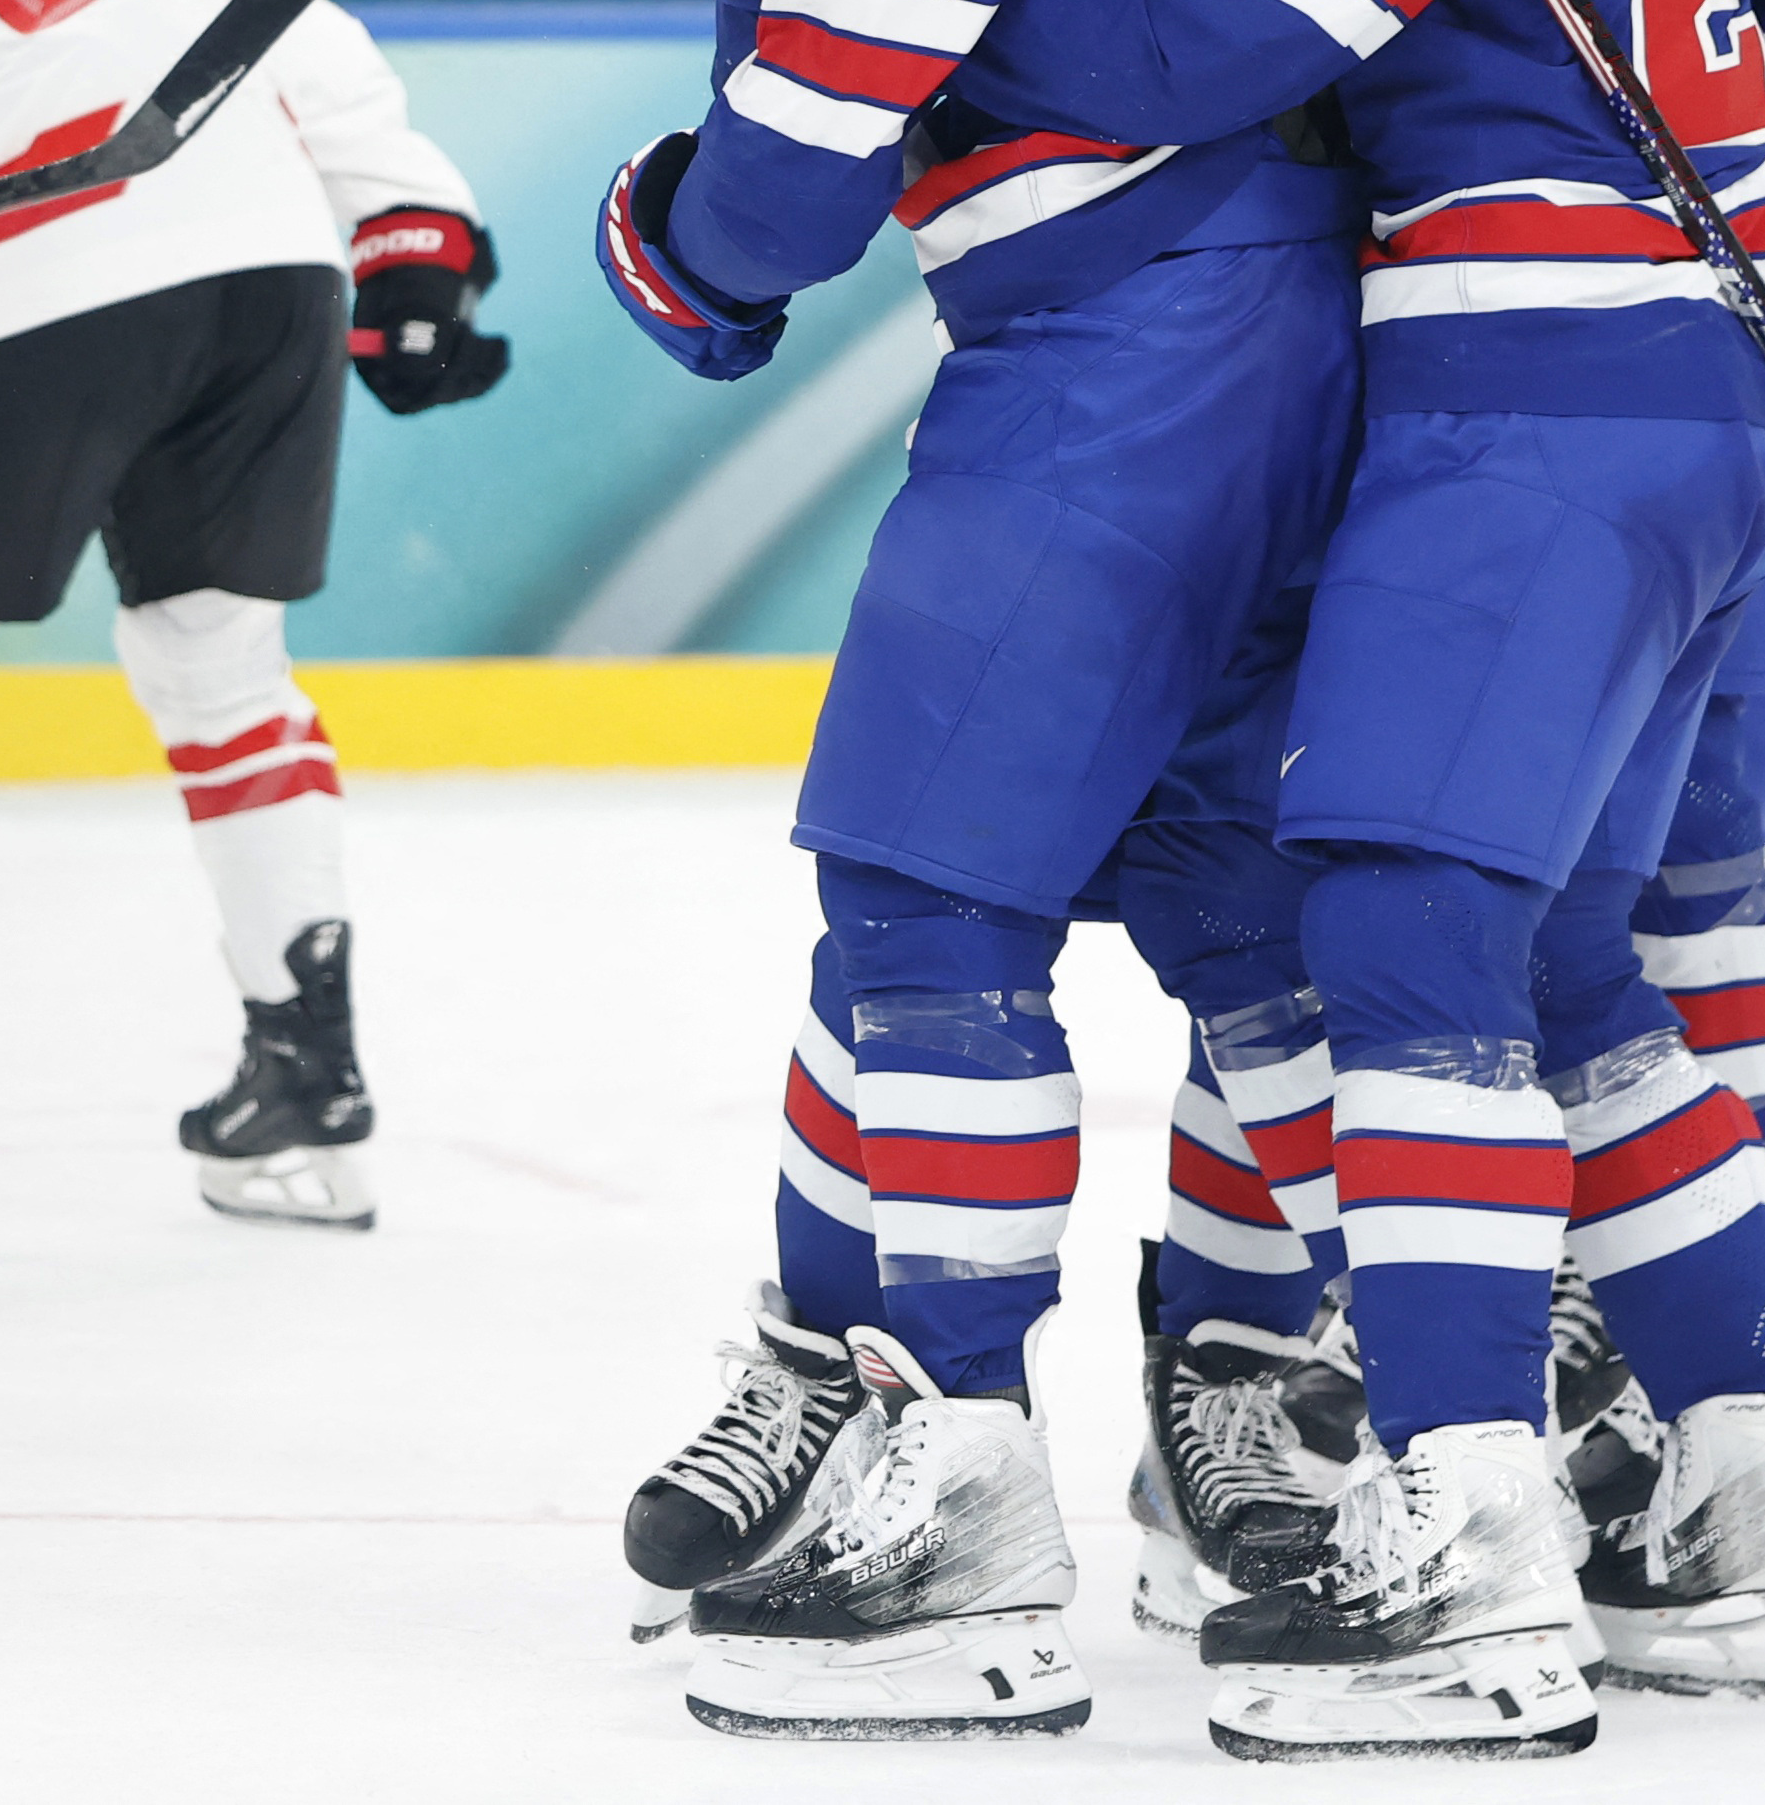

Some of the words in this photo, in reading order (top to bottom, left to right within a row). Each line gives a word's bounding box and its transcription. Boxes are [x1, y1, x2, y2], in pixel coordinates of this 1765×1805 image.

[1475, 1426, 1525, 1440] VAPOR
[849, 1527, 947, 1589] BAUER
[1666, 1527, 1724, 1572] AUER
[1029, 1663, 1072, 1680] BAUER
